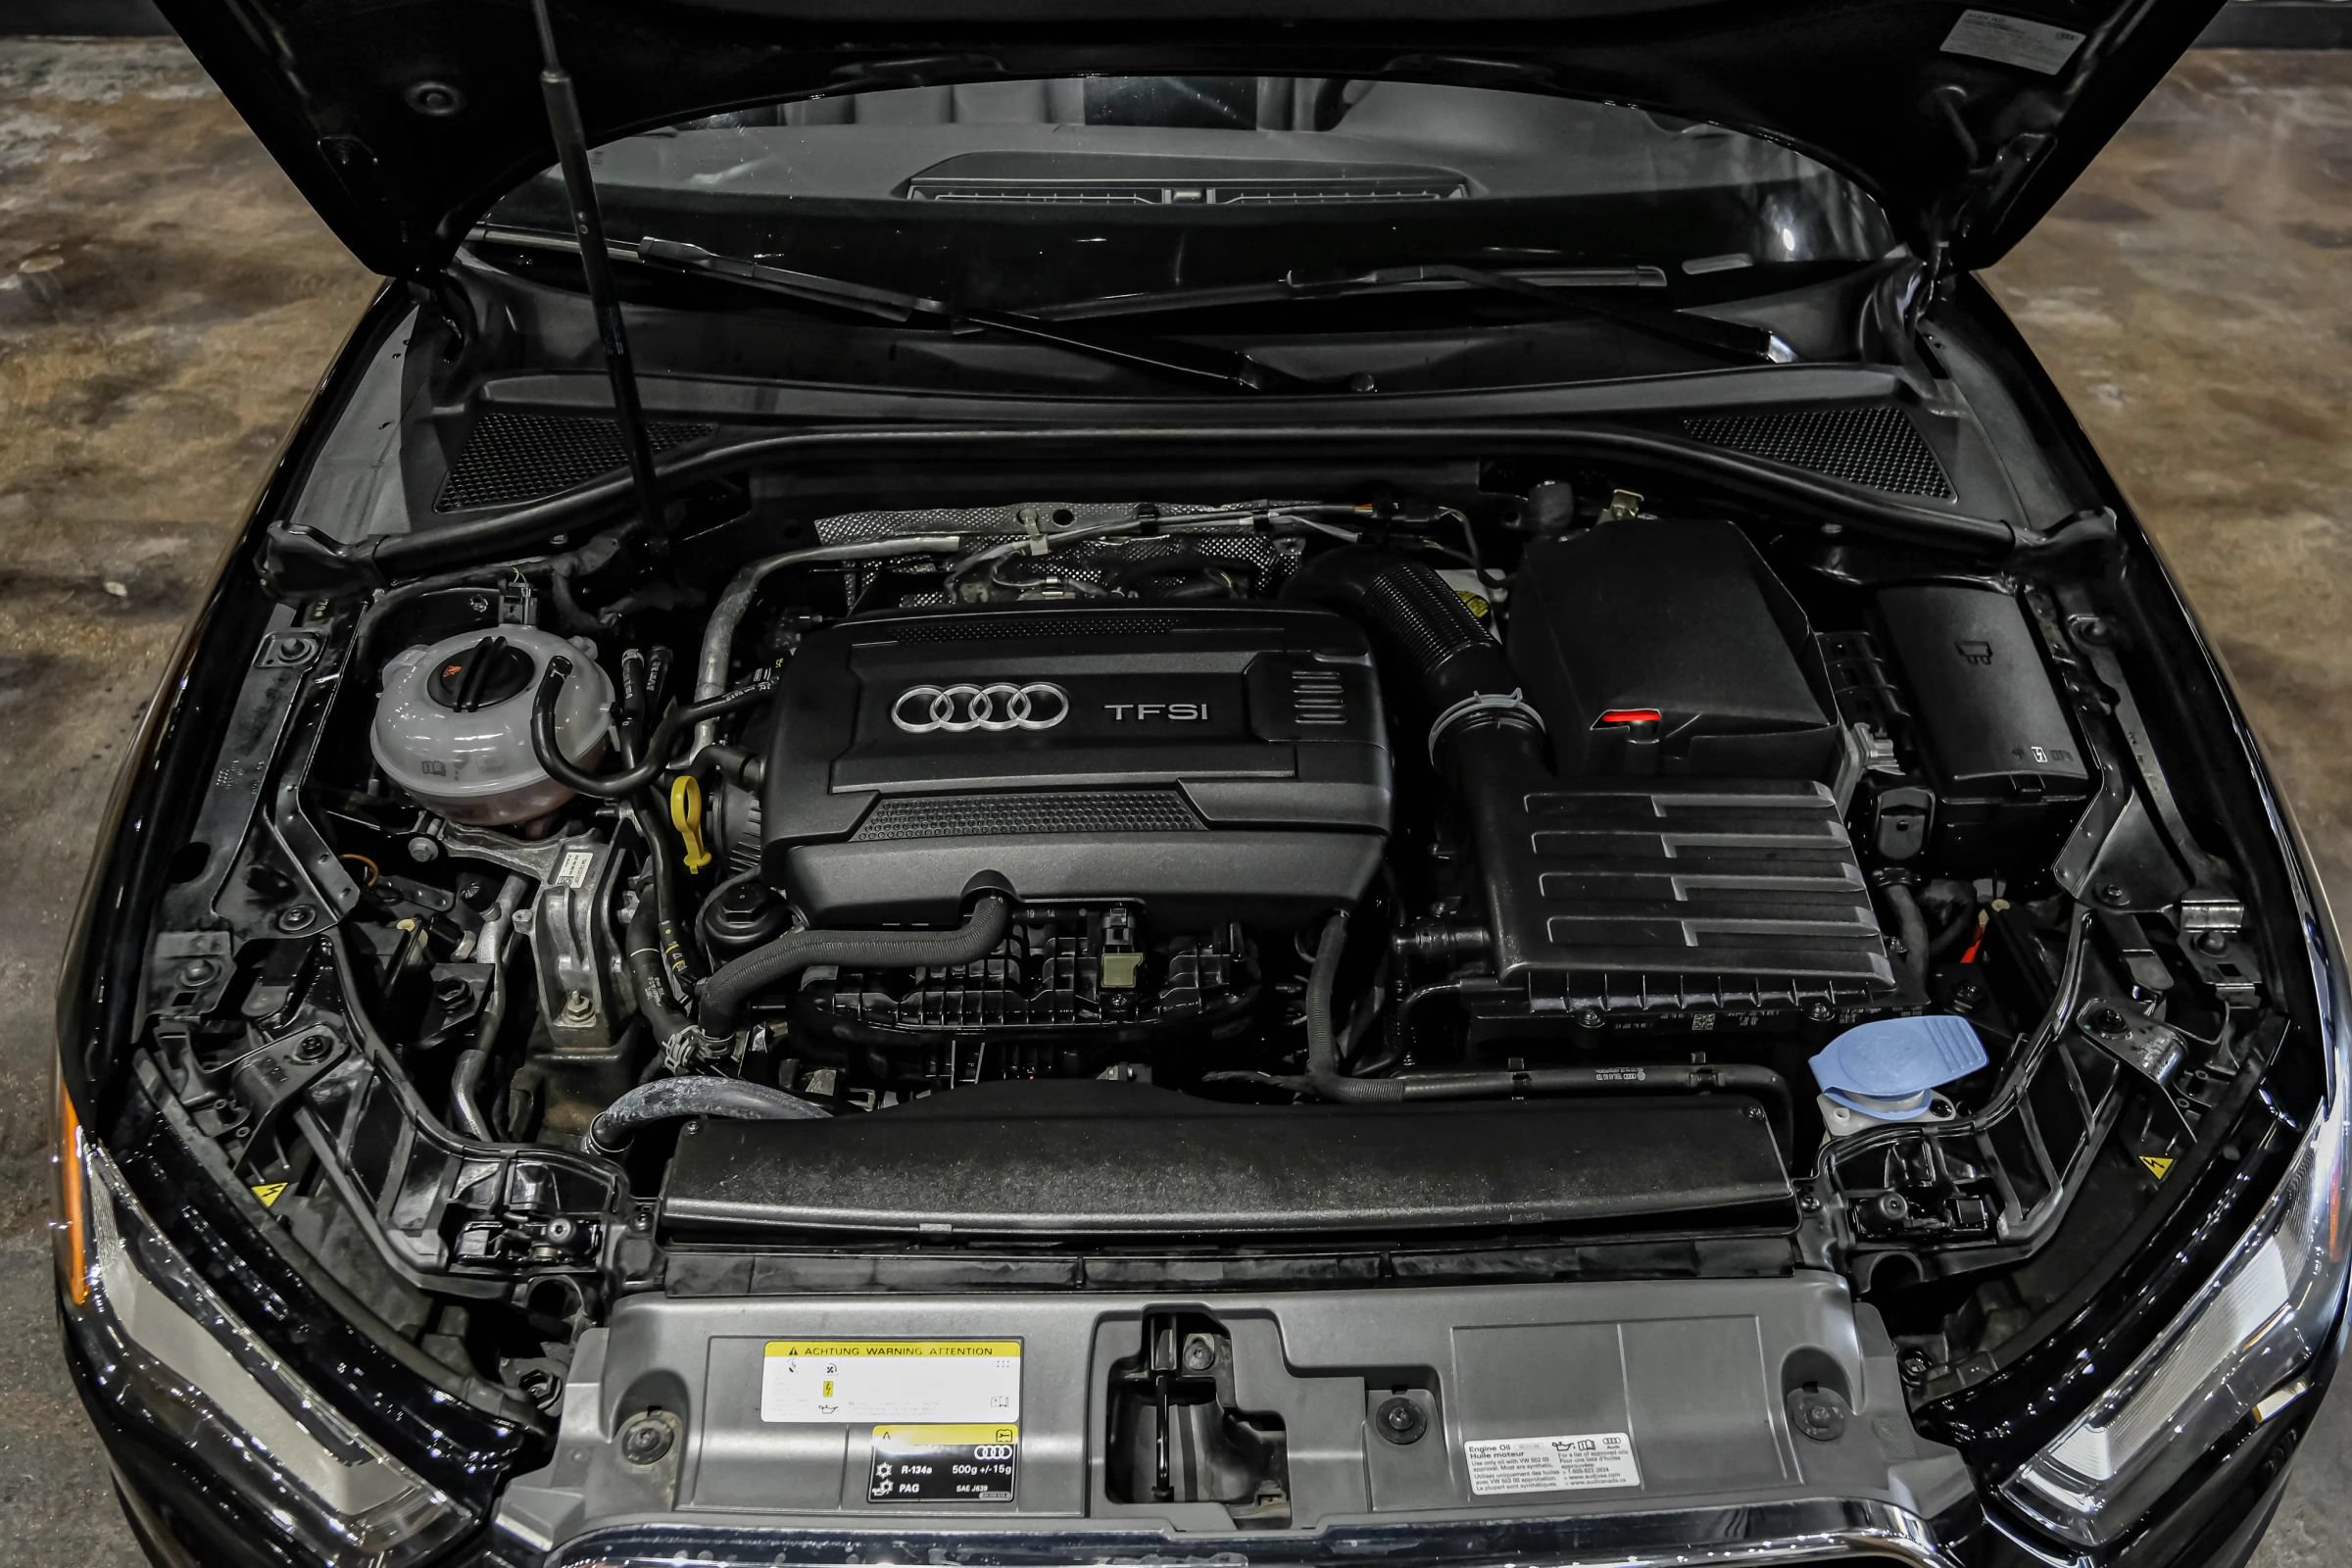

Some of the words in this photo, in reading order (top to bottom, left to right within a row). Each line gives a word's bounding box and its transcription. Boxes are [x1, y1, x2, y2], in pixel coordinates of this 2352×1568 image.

[1104, 704, 1207, 721] TFSI
[901, 1465, 932, 1474] R-134a
[953, 1465, 977, 1475] 500g
[900, 1484, 919, 1493] PAG
